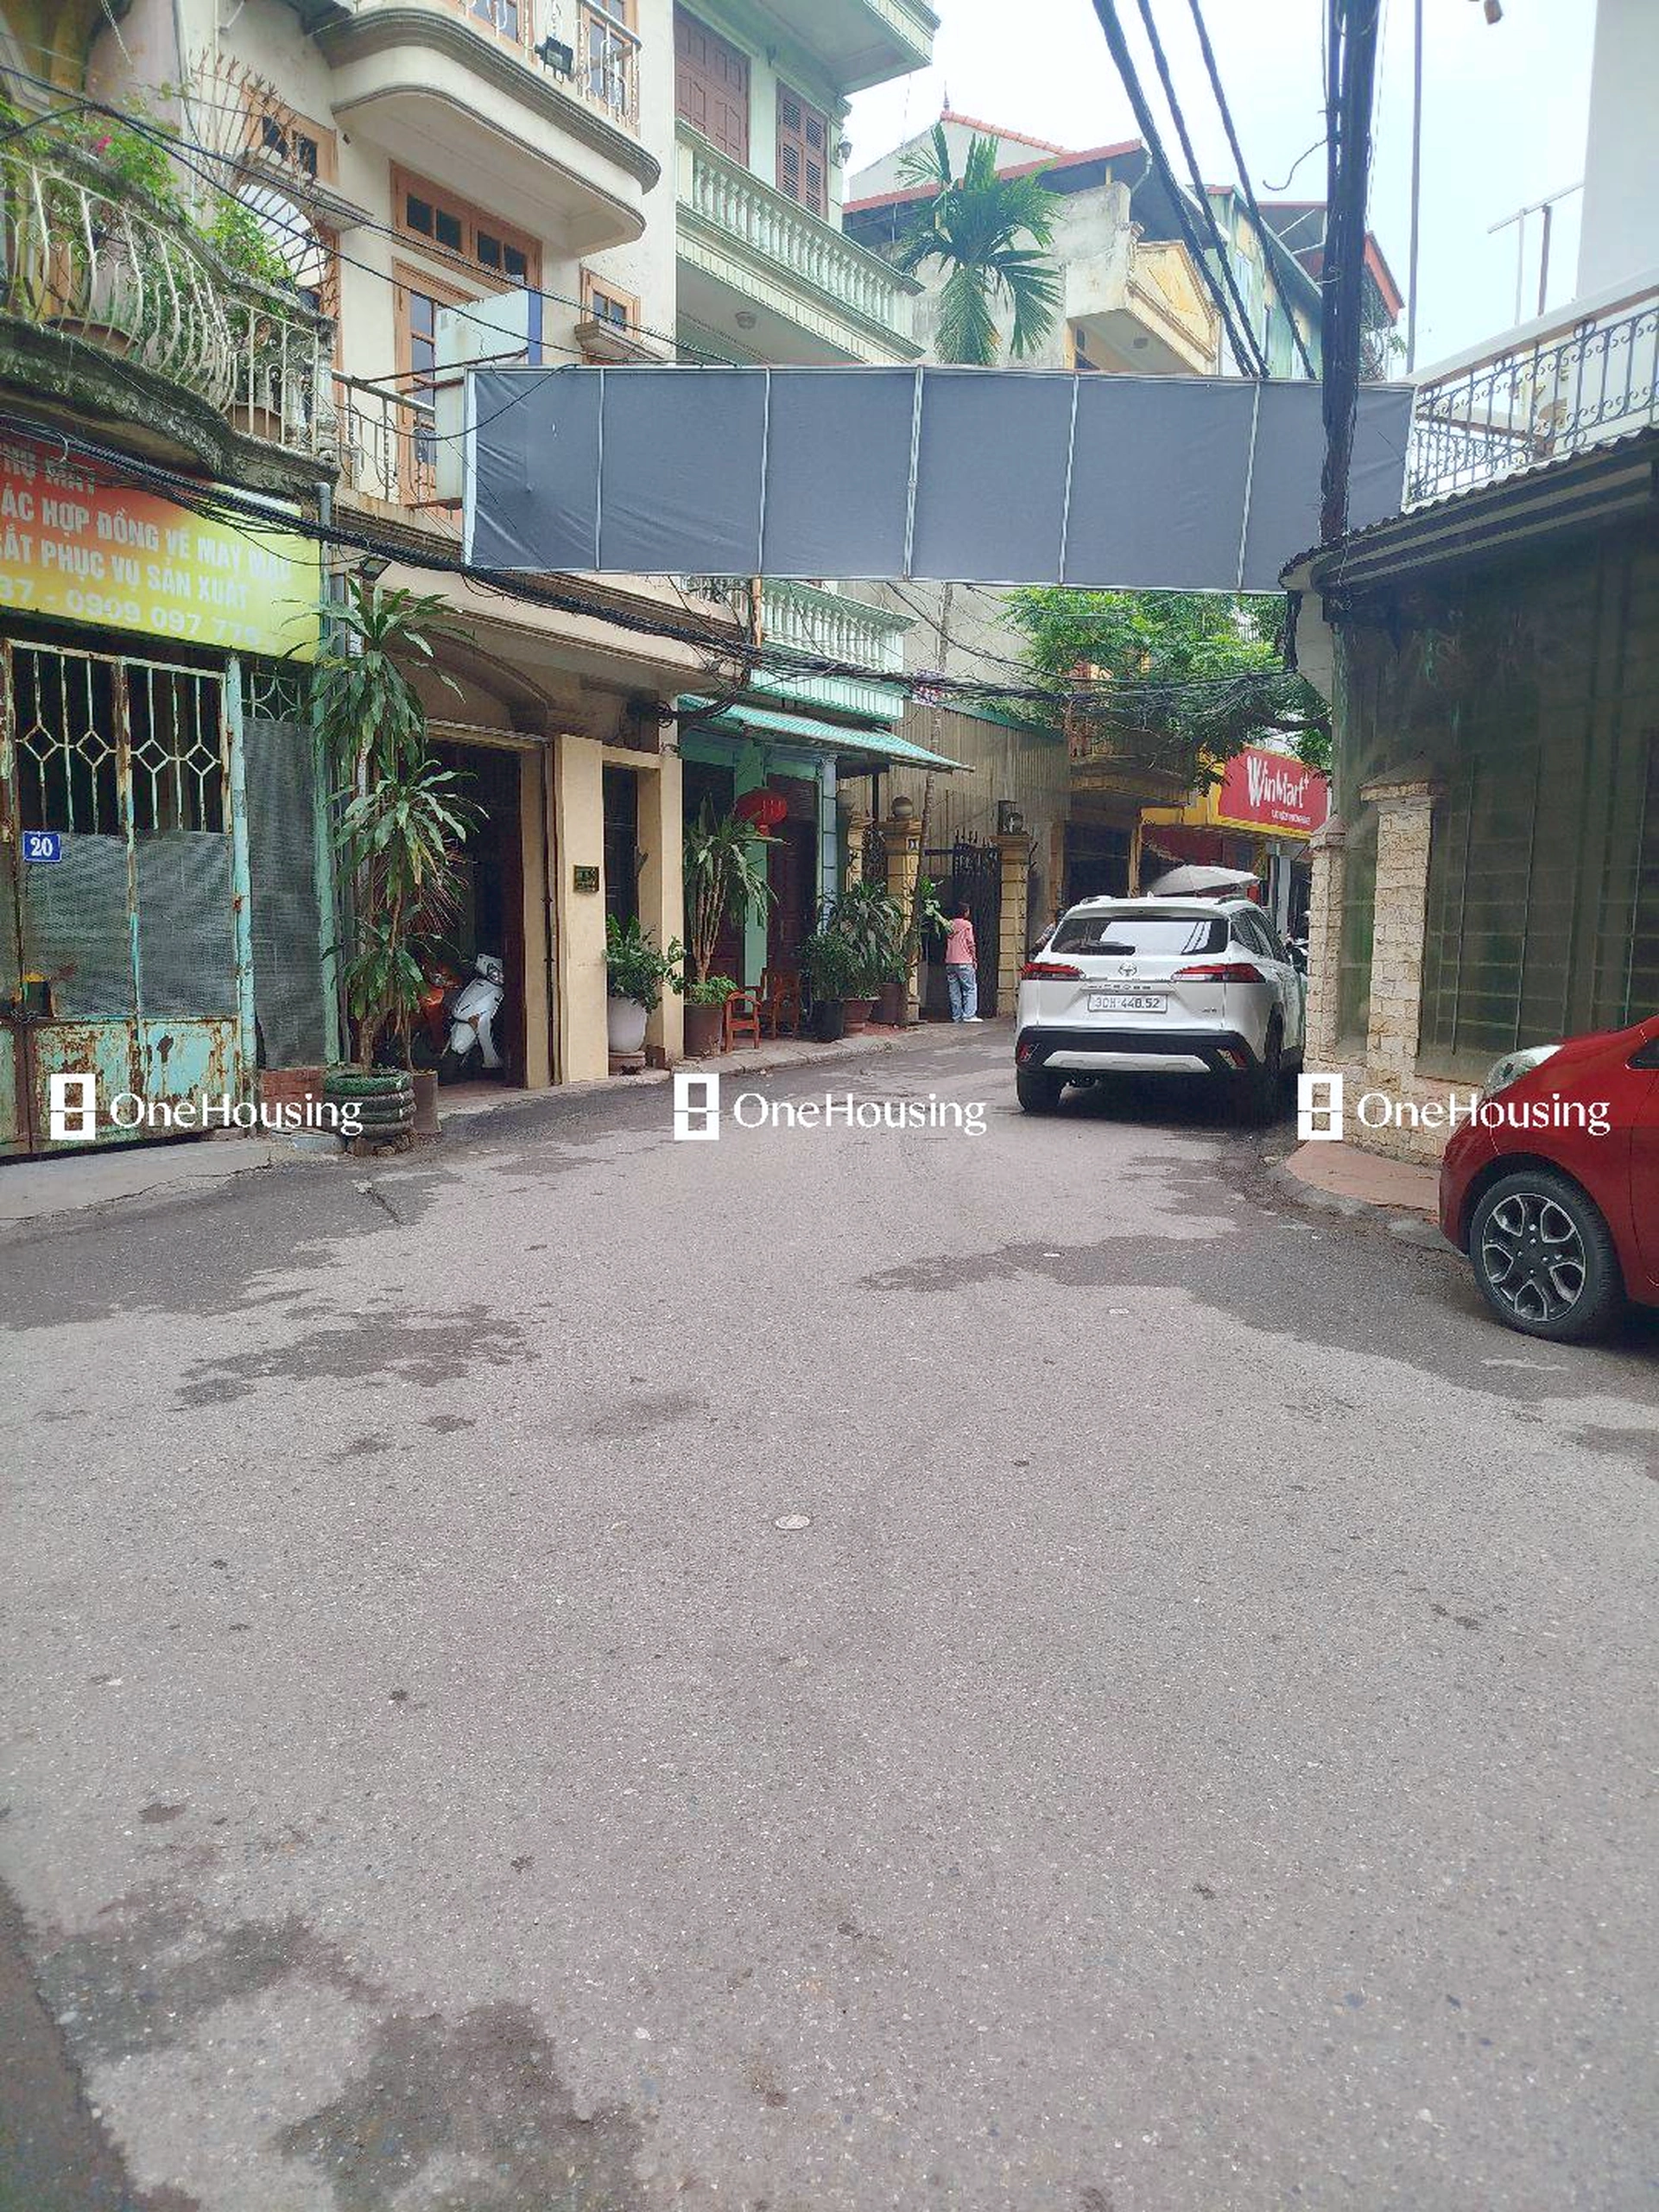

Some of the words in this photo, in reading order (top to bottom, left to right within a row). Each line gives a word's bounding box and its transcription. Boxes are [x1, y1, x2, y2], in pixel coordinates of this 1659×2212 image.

[97, 507, 159, 552] ĐỒNG
[41, 538, 105, 582] PHỤC
[150, 605, 201, 637] 097
[29, 836, 53, 857] 20
